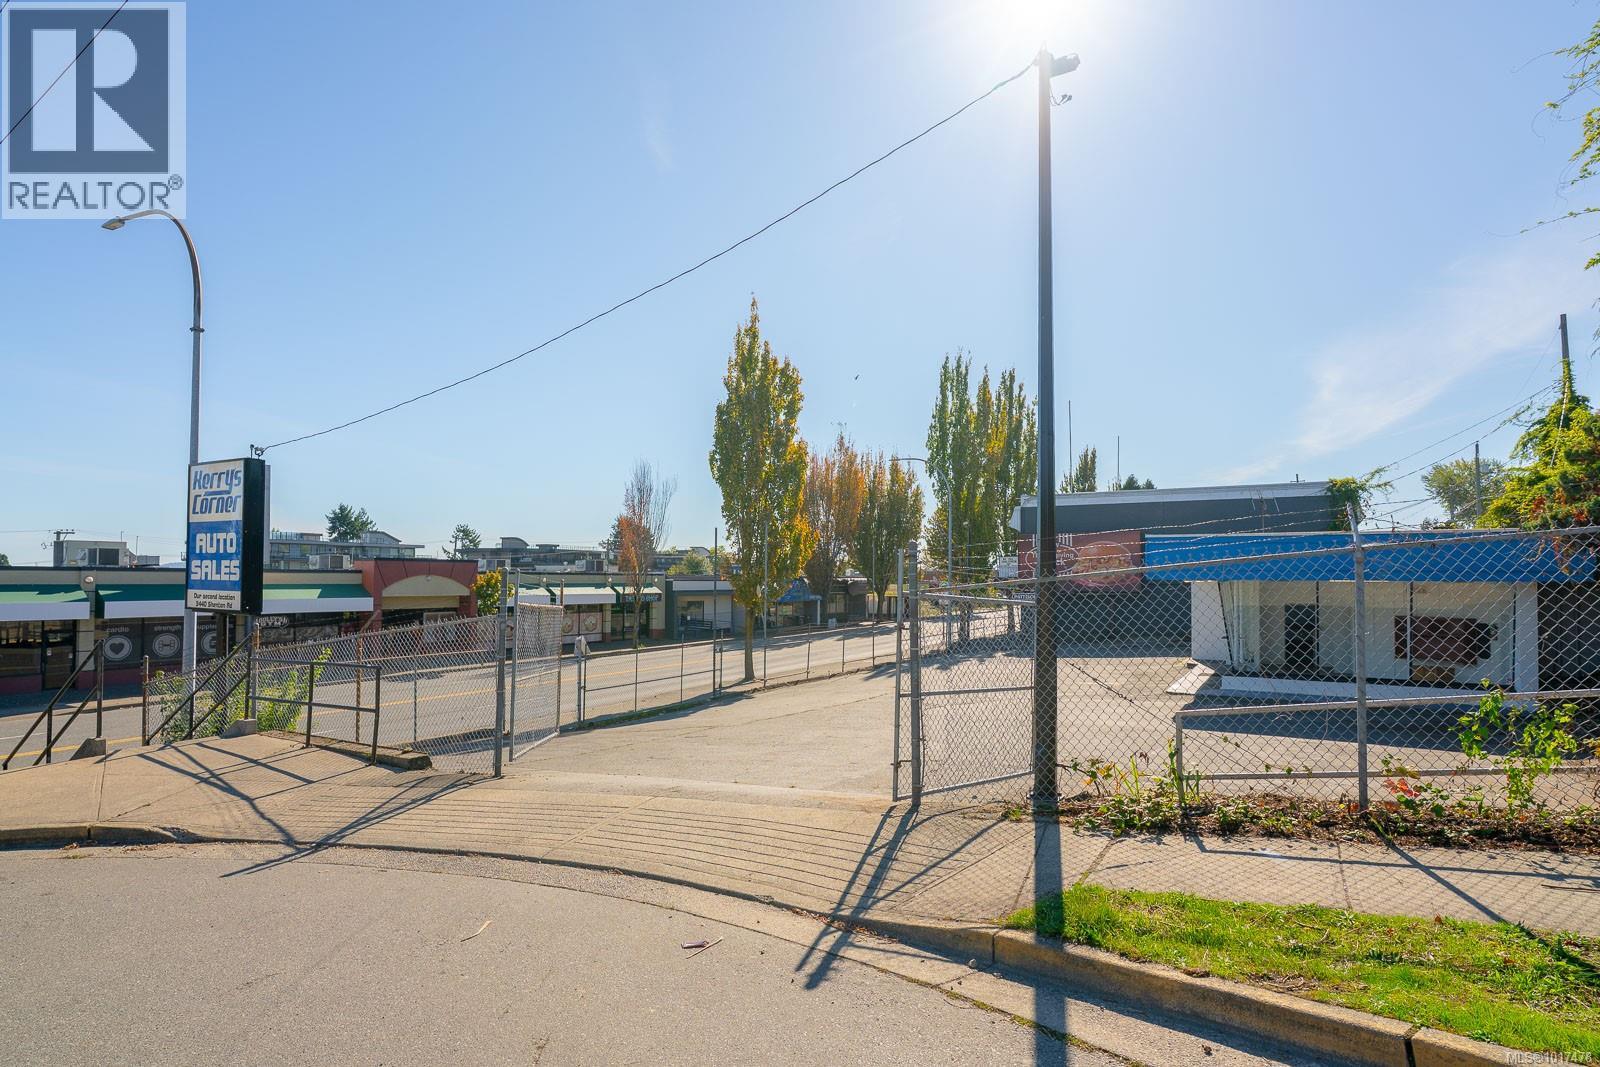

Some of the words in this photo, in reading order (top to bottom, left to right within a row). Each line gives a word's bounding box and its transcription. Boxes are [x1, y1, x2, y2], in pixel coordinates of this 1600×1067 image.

[191, 494, 241, 515] Corner
[196, 532, 237, 554] AUTO
[190, 559, 240, 582] SALES
[218, 593, 236, 601] location
[106, 625, 130, 633] cardio
[154, 624, 182, 632] strength
